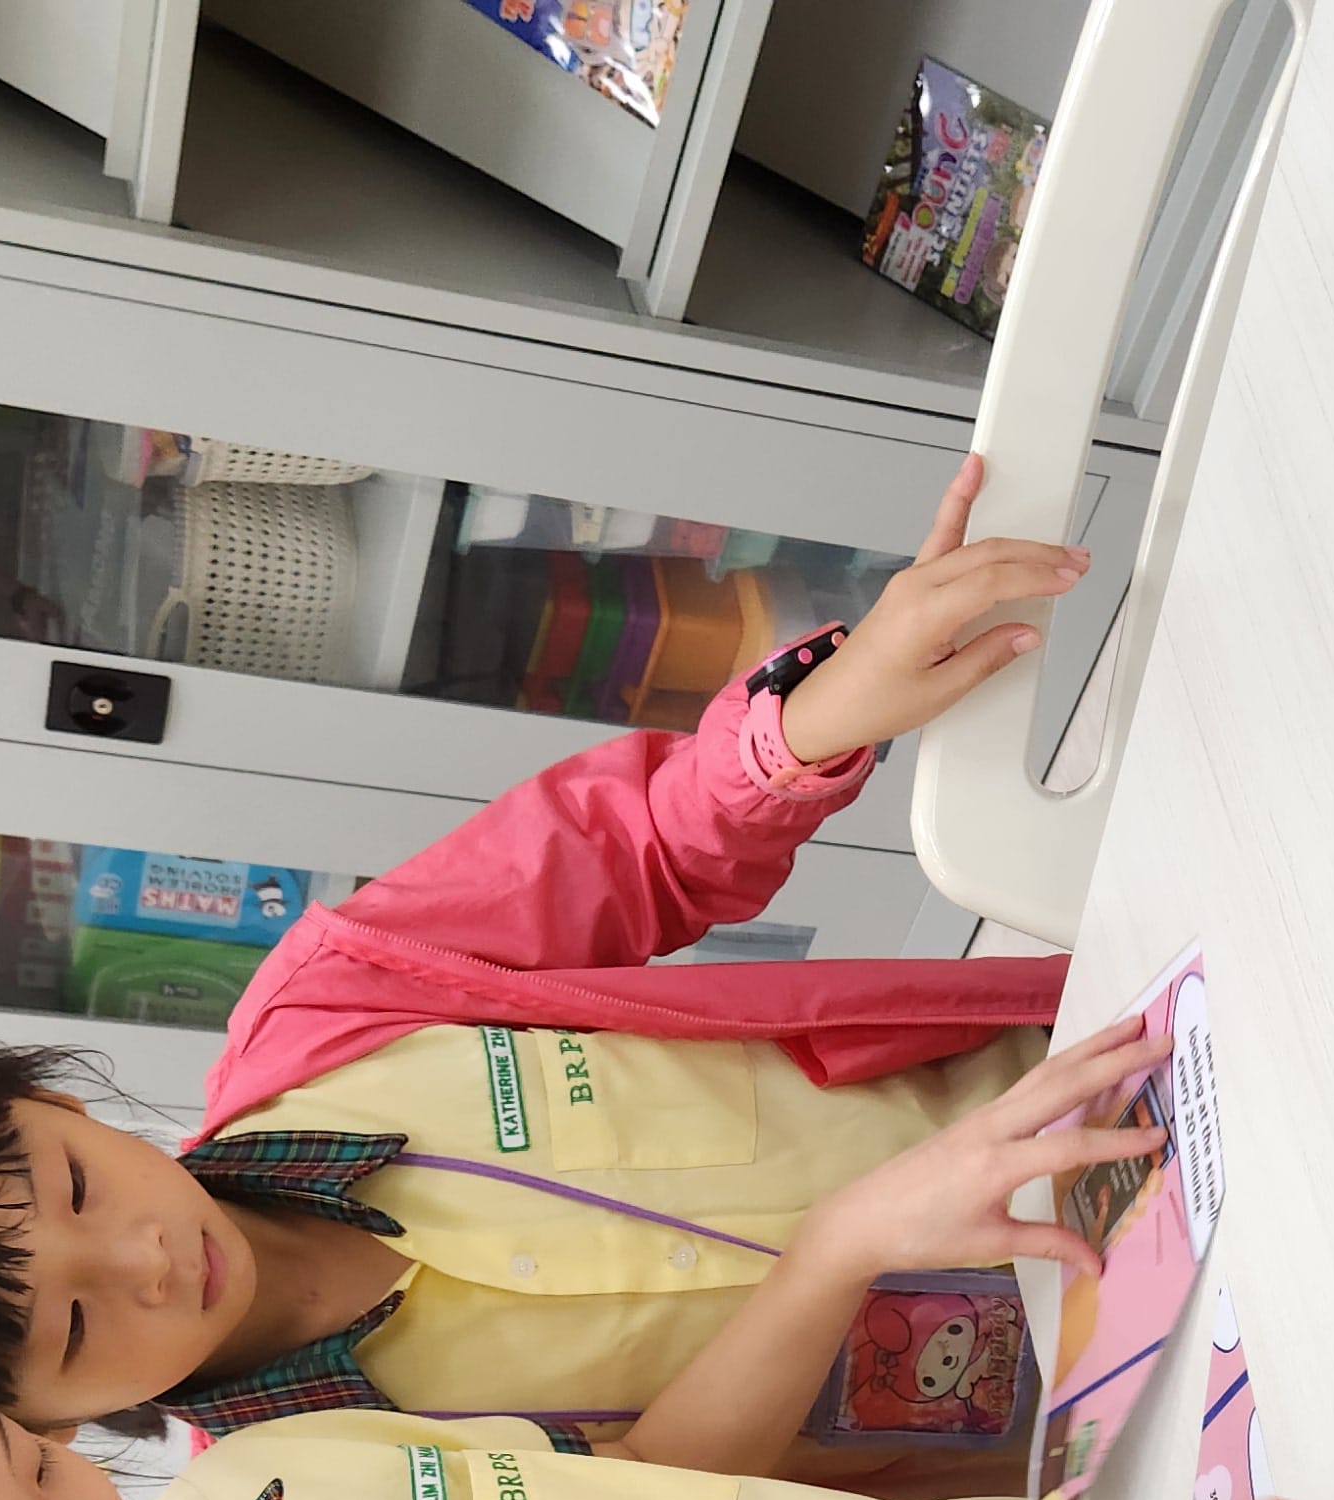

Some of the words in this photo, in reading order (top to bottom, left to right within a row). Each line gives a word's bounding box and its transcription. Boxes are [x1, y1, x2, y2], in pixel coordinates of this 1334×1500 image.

[142, 888, 238, 916] MATHS
[495, 1055, 520, 1136] KATHERINE
[1177, 1055, 1191, 1106] every
[1187, 1025, 1207, 1098] looking
[1199, 1126, 1212, 1156] the
[989, 1297, 1009, 1374] Melody
